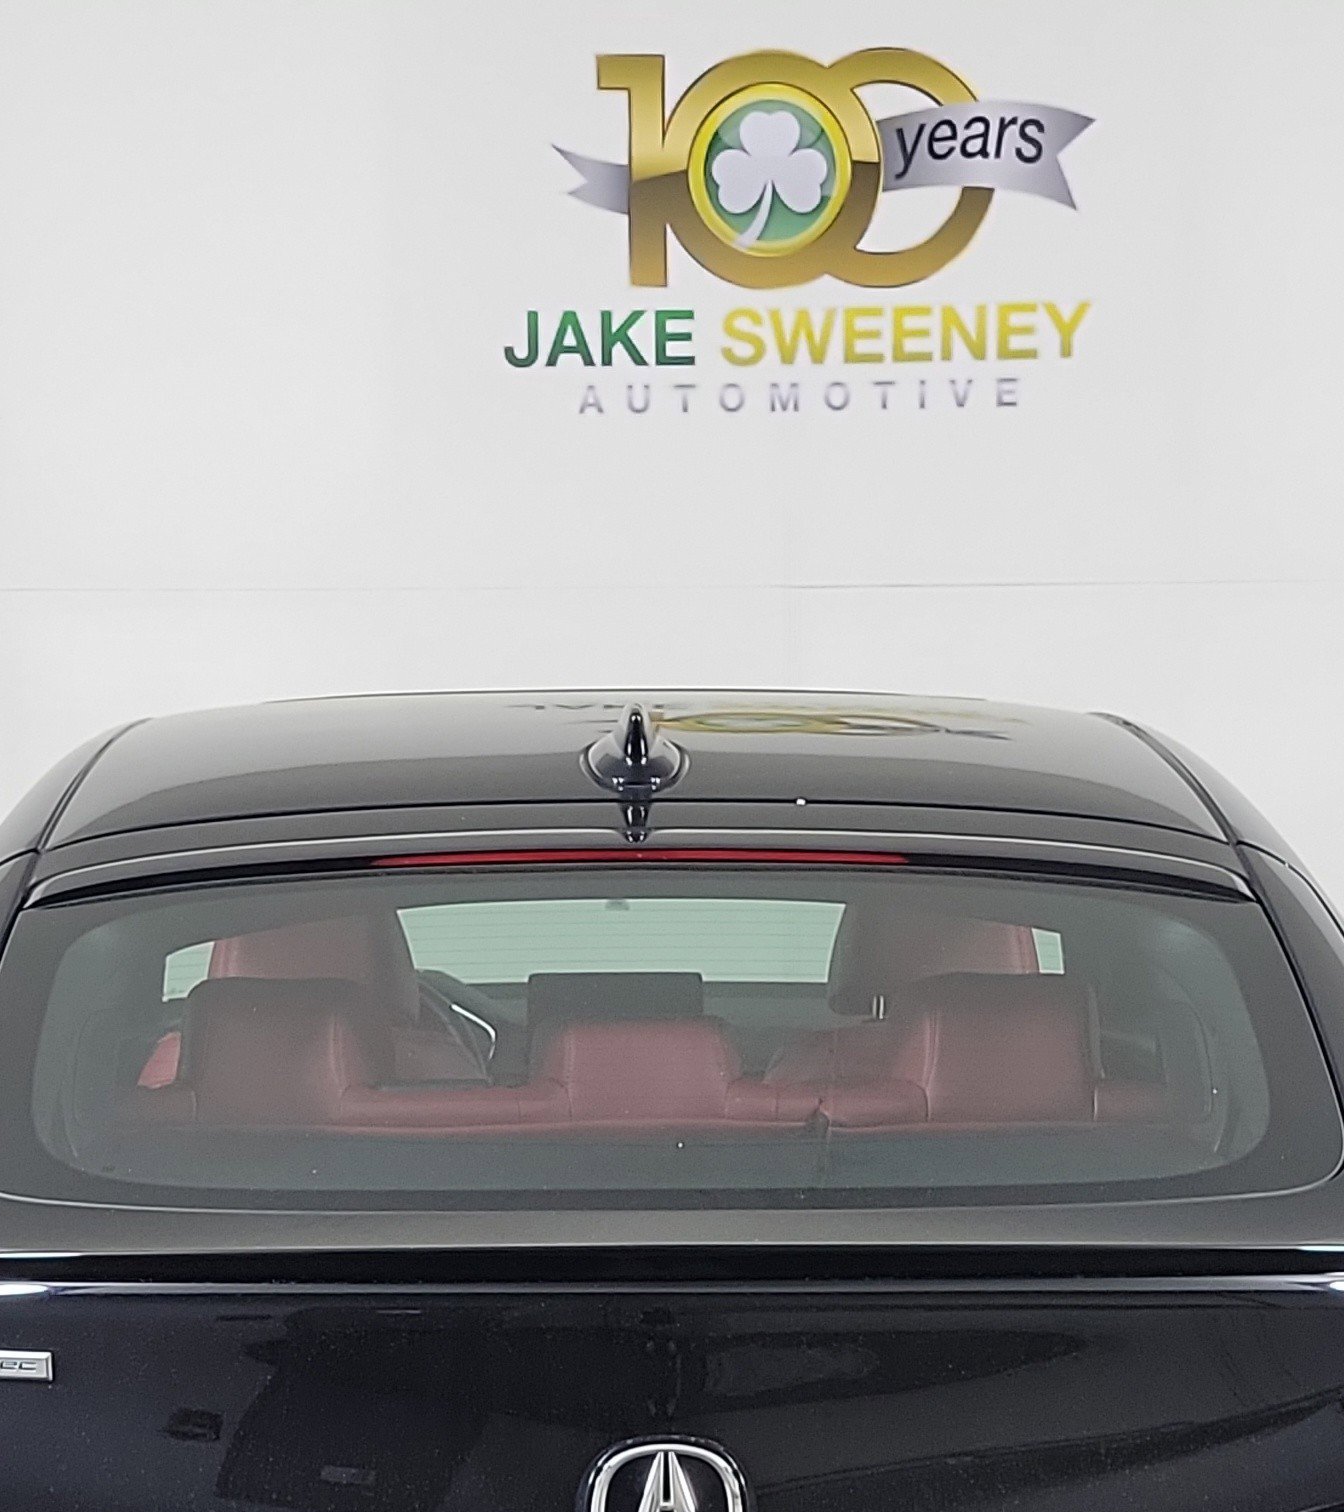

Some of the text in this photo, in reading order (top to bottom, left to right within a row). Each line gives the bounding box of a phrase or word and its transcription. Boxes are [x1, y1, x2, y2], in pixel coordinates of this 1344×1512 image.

[895, 114, 1045, 180] years
[503, 301, 1092, 368] JAKE SWEENEY
[579, 378, 1019, 414] AUTOMOTIVE
